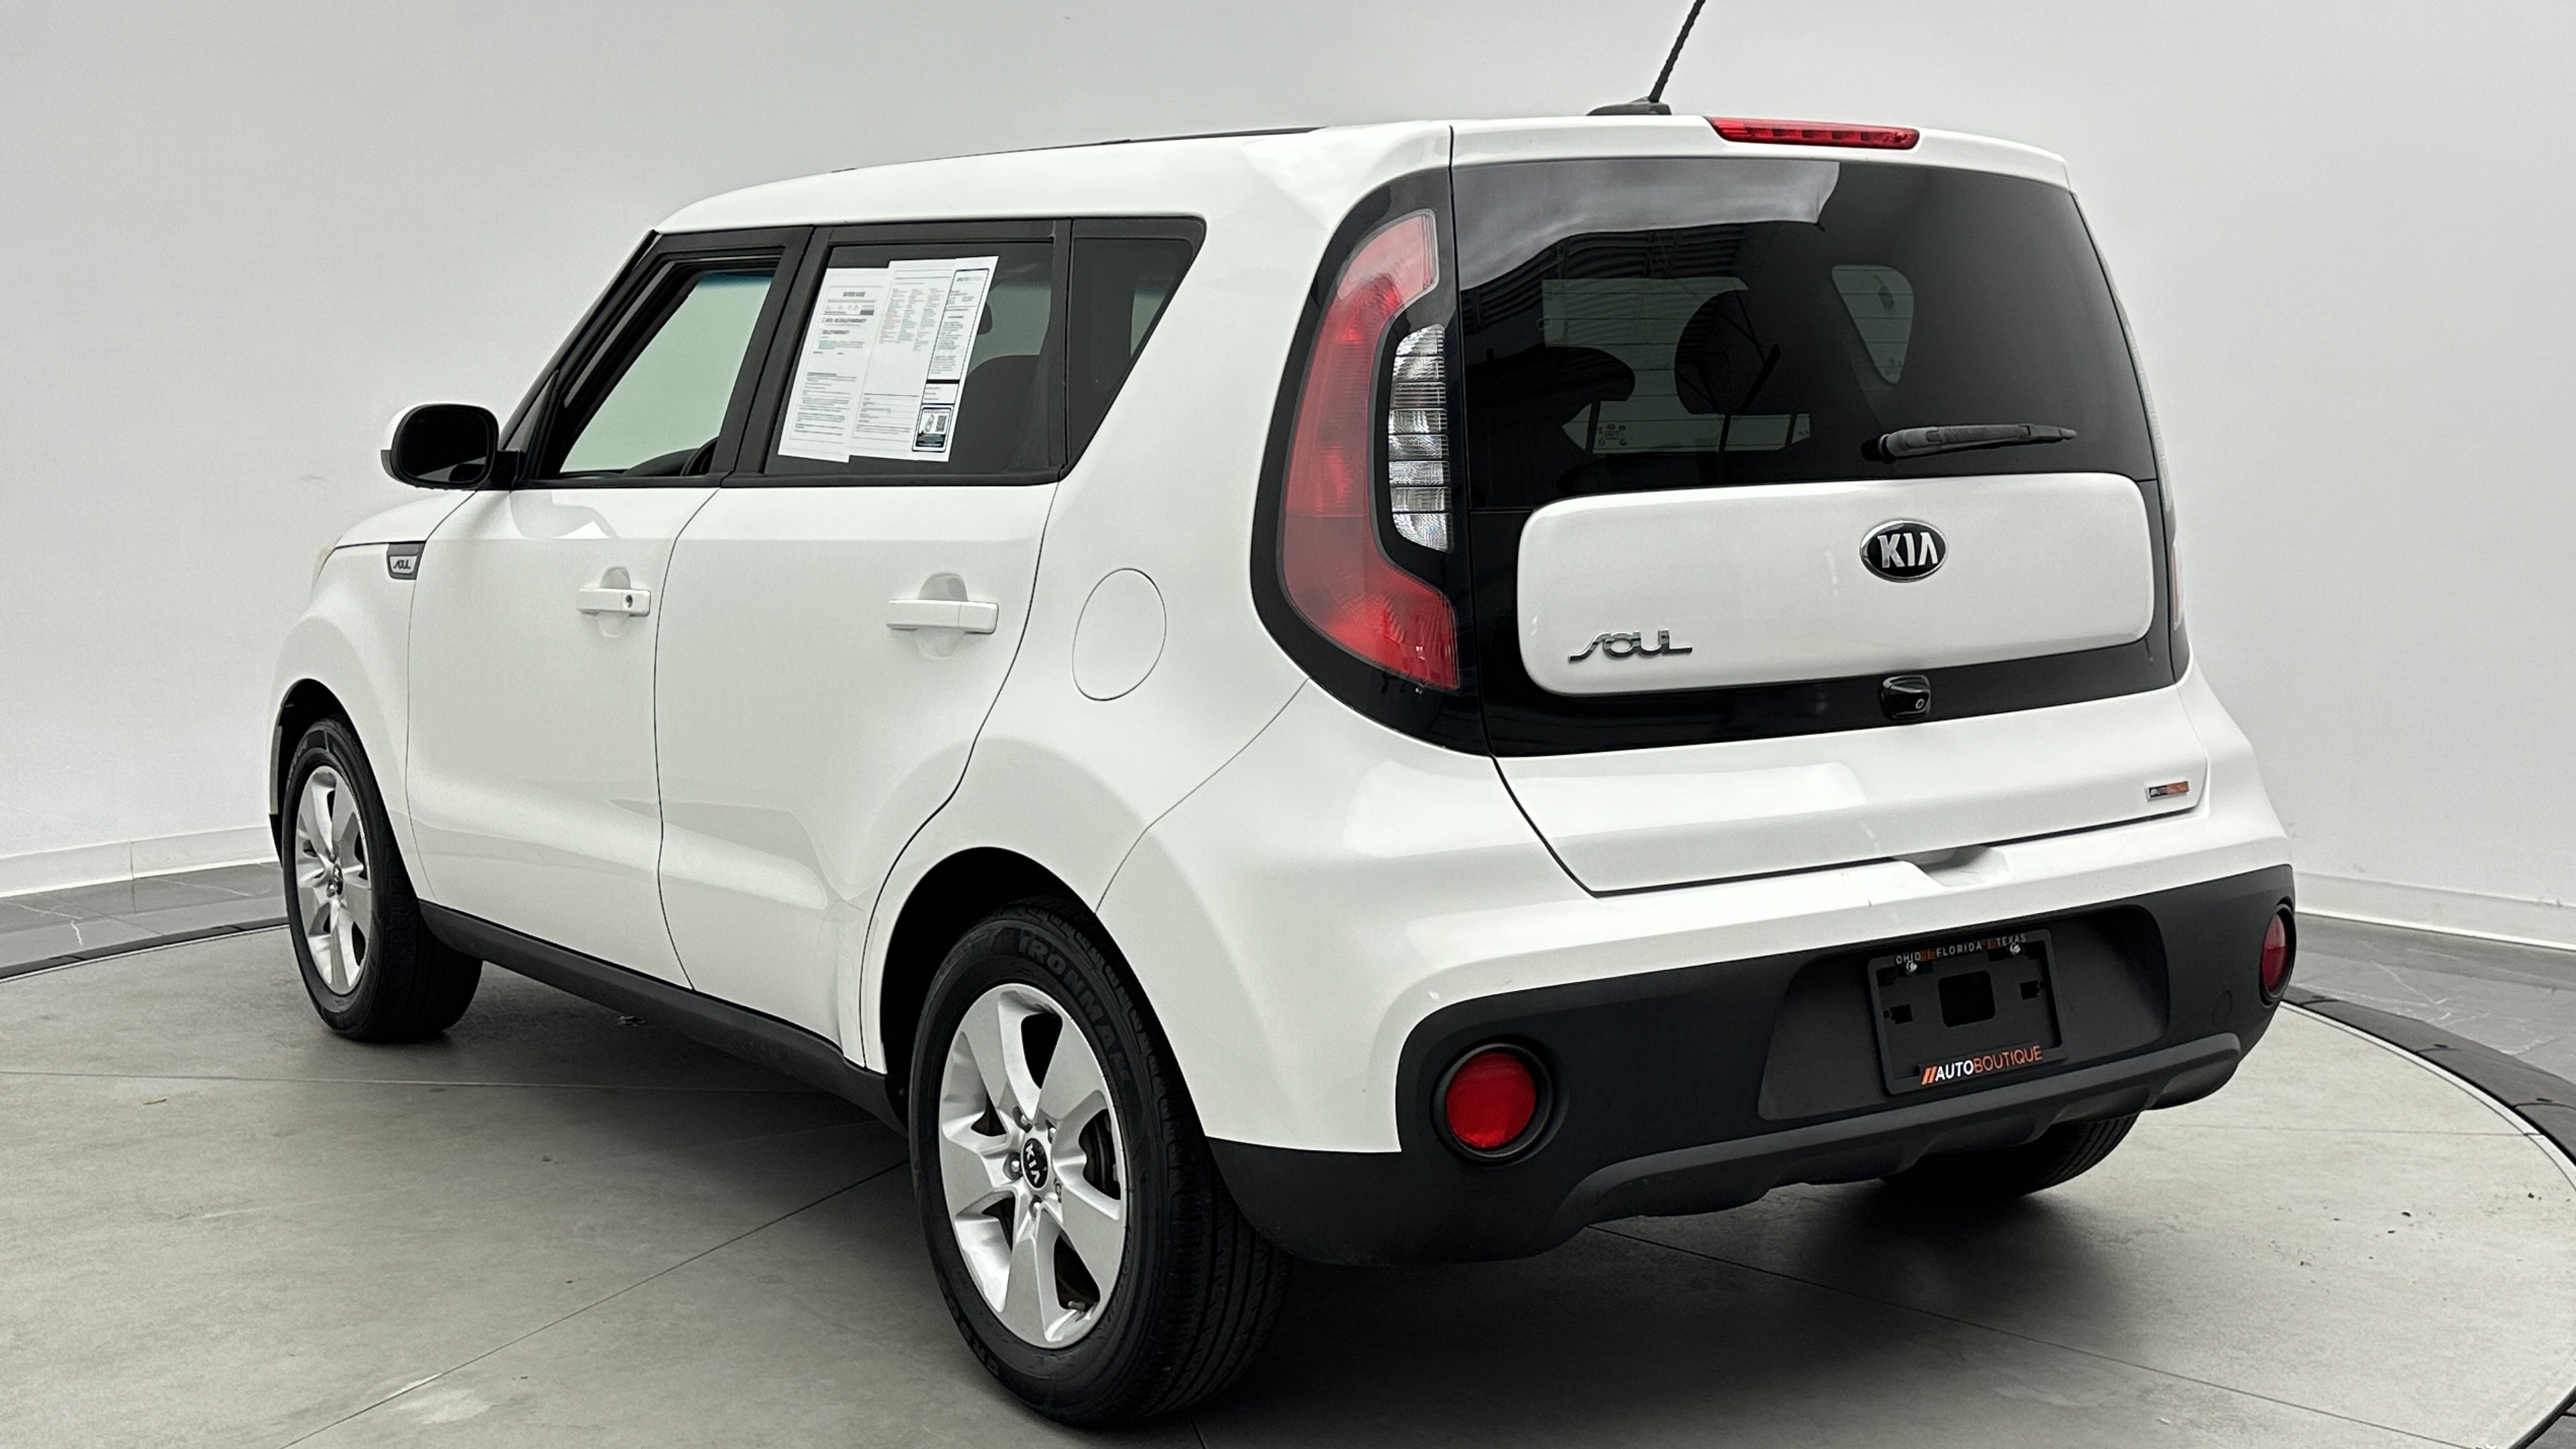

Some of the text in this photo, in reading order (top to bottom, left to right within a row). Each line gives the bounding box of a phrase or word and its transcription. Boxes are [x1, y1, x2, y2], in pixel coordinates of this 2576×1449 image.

[1877, 532, 1938, 568] KIA
[1568, 629, 1693, 664] SOUL
[1896, 933, 2027, 965] OHIO FLORIDA TEXAS
[1018, 934, 1130, 1081] IRONMAN
[1935, 1045, 2043, 1082] AUTOBOUTIQUE
[1025, 1142, 1040, 1184] KIA
